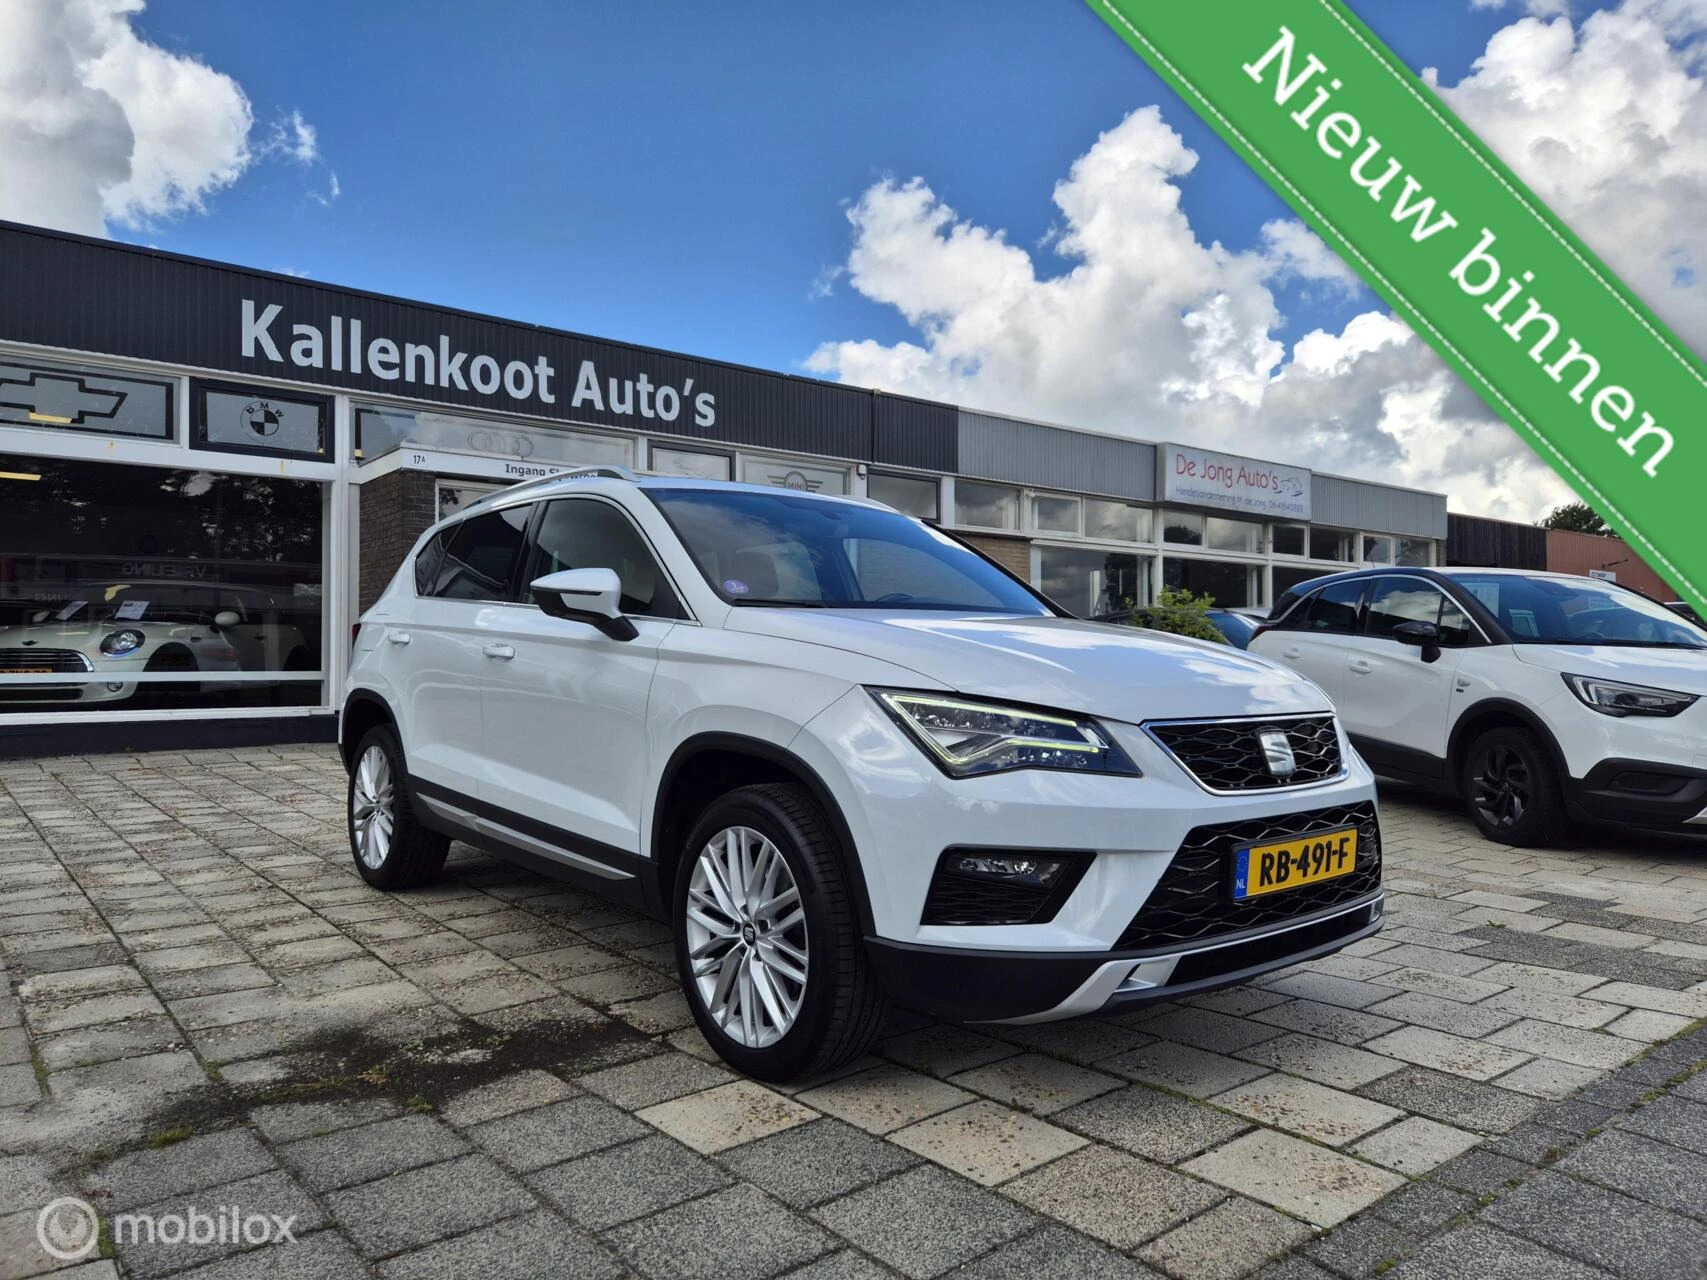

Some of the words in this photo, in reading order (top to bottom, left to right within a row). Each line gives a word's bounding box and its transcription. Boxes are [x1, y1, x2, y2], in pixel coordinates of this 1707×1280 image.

[241, 298, 555, 404] Kallenkoot
[571, 360, 716, 427] Auto's
[245, 402, 284, 417] BMW
[1176, 453, 1196, 477] De
[1200, 458, 1233, 489] Jong
[1237, 464, 1279, 491] Auto's
[1259, 837, 1350, 887] RB-491-F
[1236, 878, 1246, 889] NL
